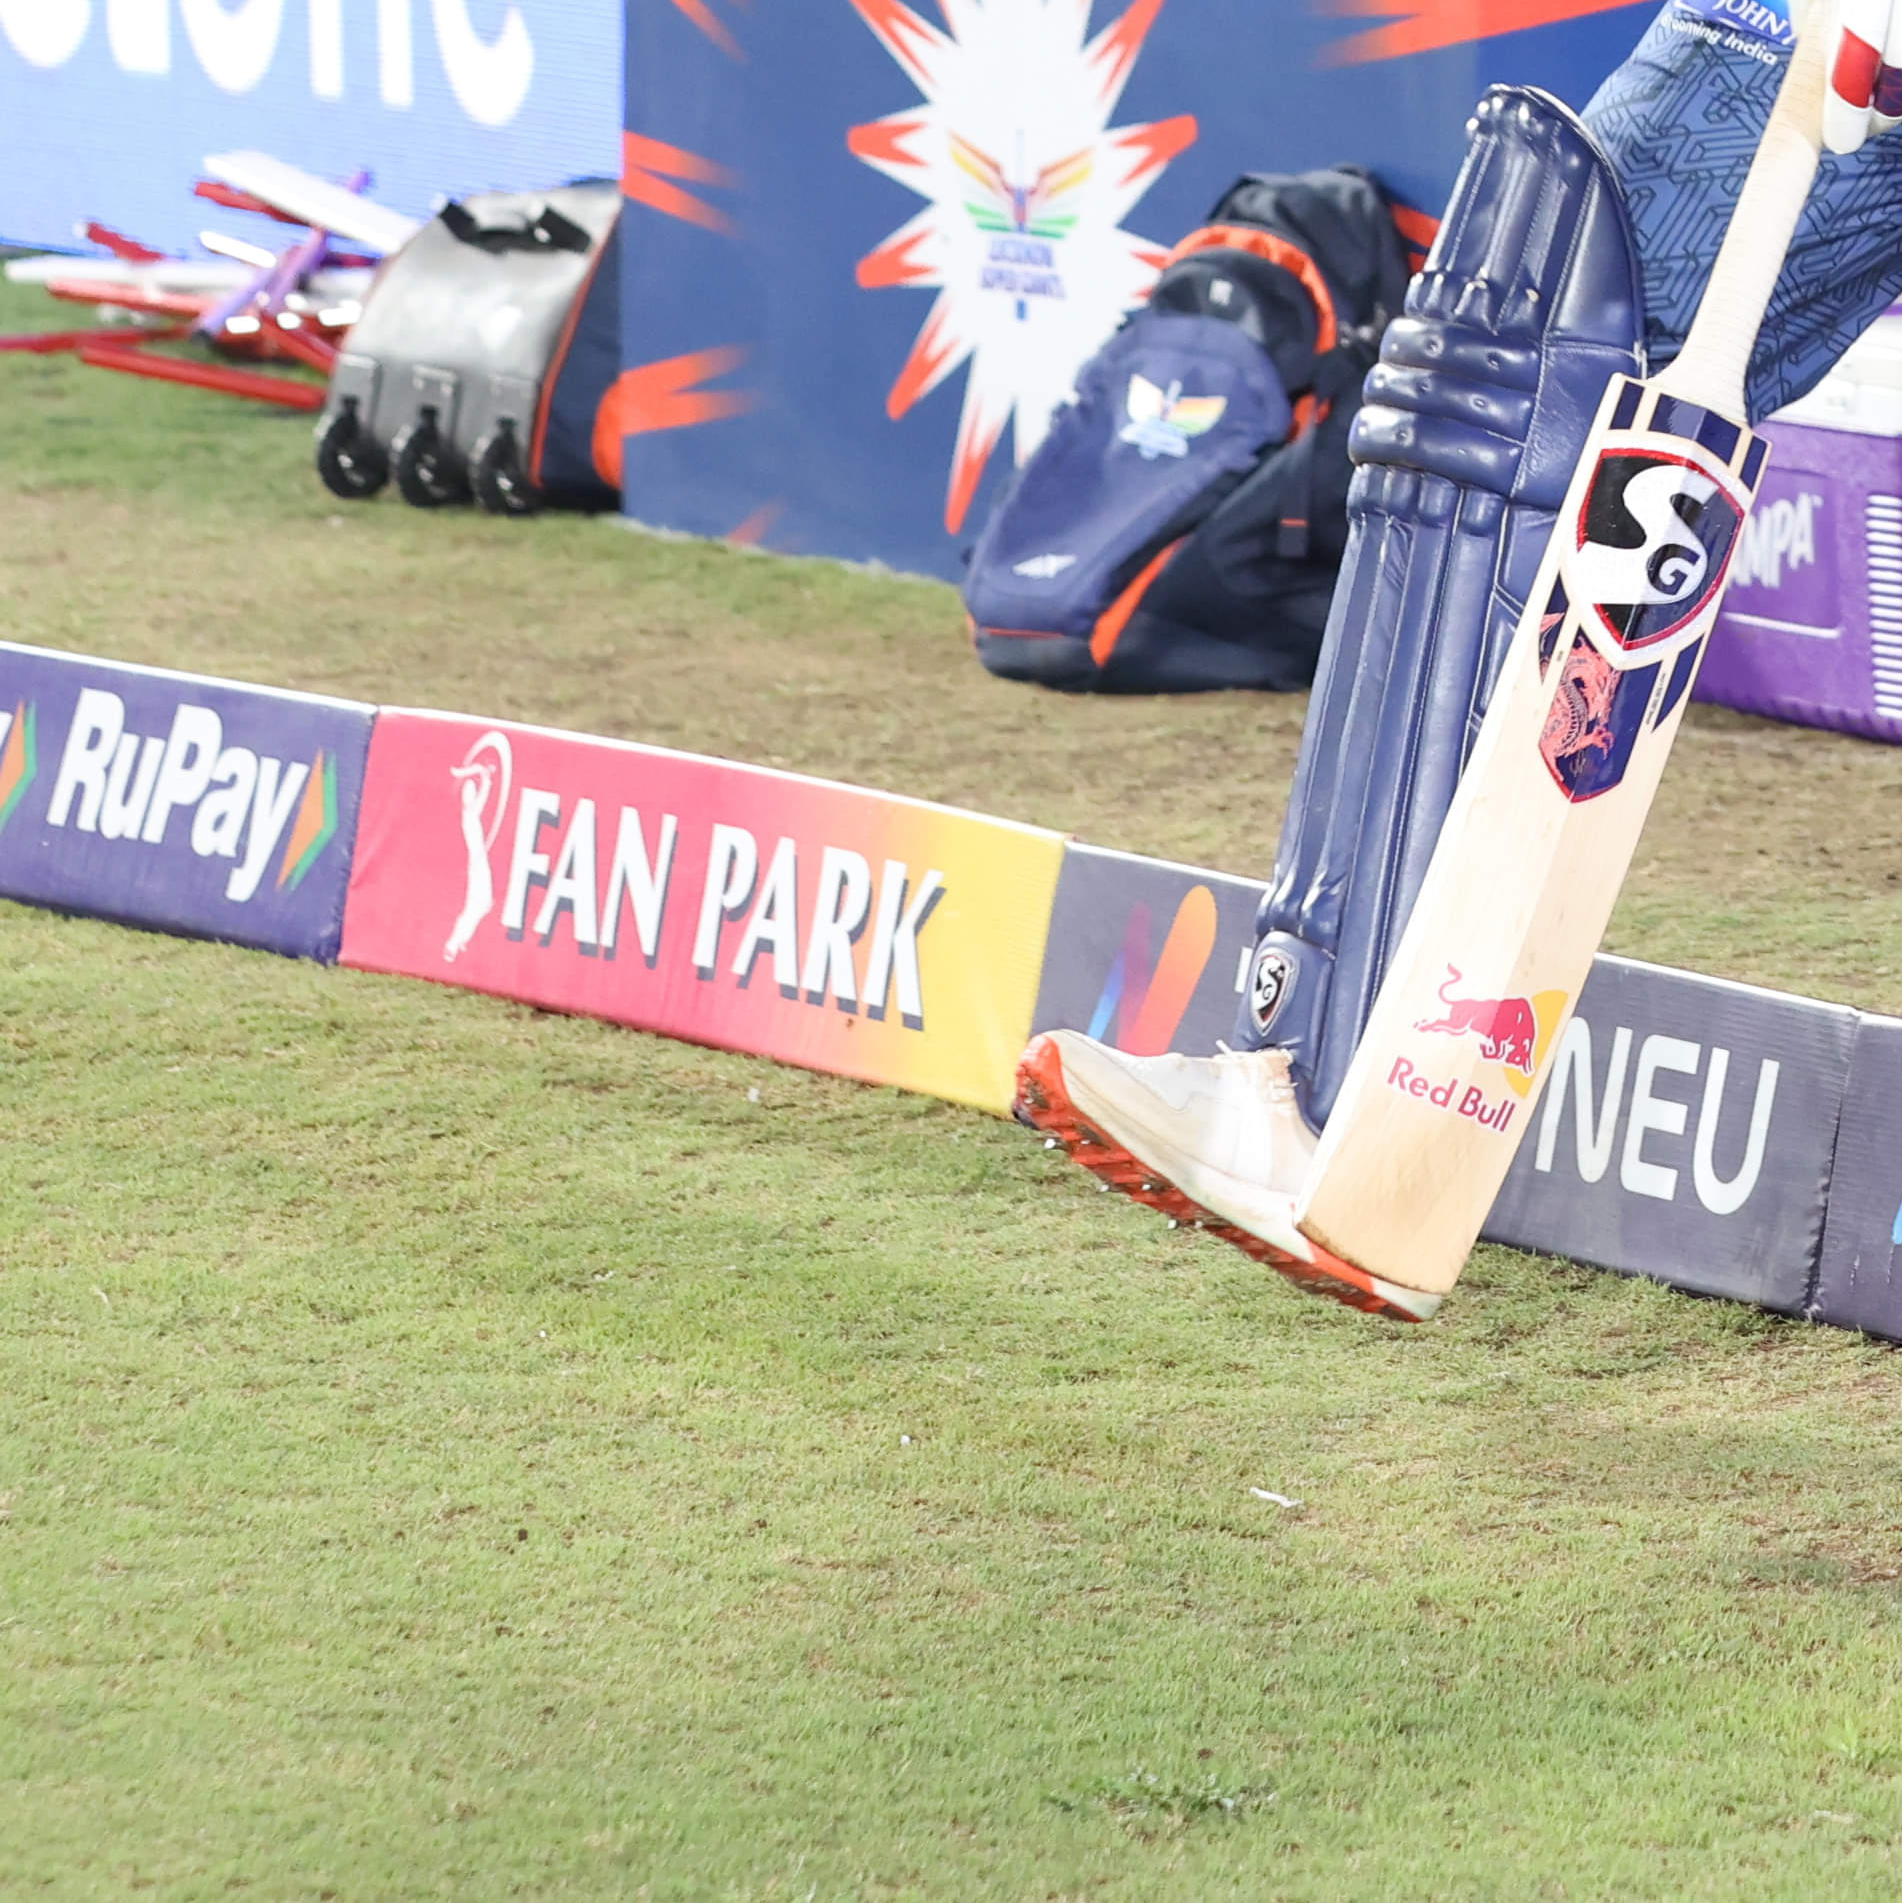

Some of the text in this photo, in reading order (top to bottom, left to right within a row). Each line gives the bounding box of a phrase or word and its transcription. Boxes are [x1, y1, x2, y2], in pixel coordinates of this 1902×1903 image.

[1723, 32, 1779, 66] India
[1727, 493, 1816, 590] MPA
[46, 687, 308, 904] RuPay
[502, 788, 946, 1031] FAN PARK
[1387, 1056, 1517, 1133] Red Bull
[1534, 1014, 1780, 1216] NEU
